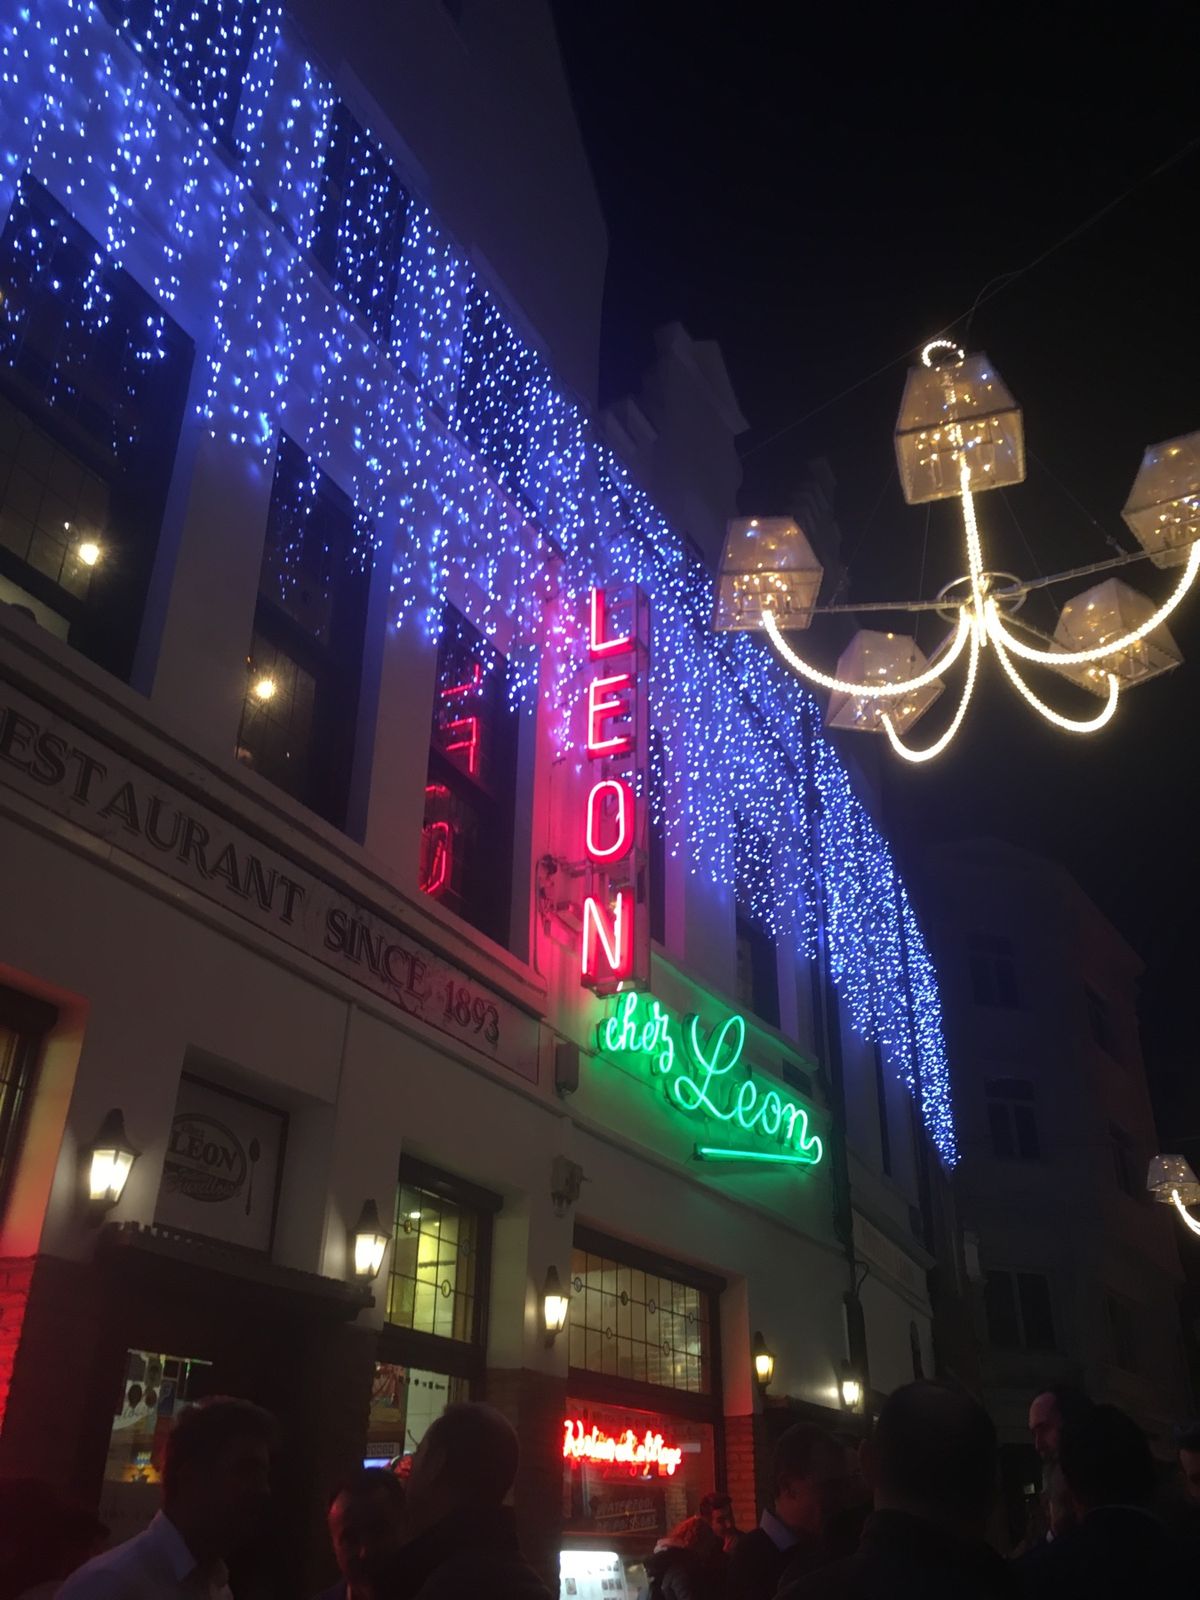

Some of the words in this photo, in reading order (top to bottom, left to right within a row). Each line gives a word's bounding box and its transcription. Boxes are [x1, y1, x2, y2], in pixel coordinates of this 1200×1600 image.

[580, 585, 633, 978] LEON
[324, 906, 428, 998] SINCE
[442, 979, 500, 1045] 1893
[673, 1013, 824, 1166] Leon
